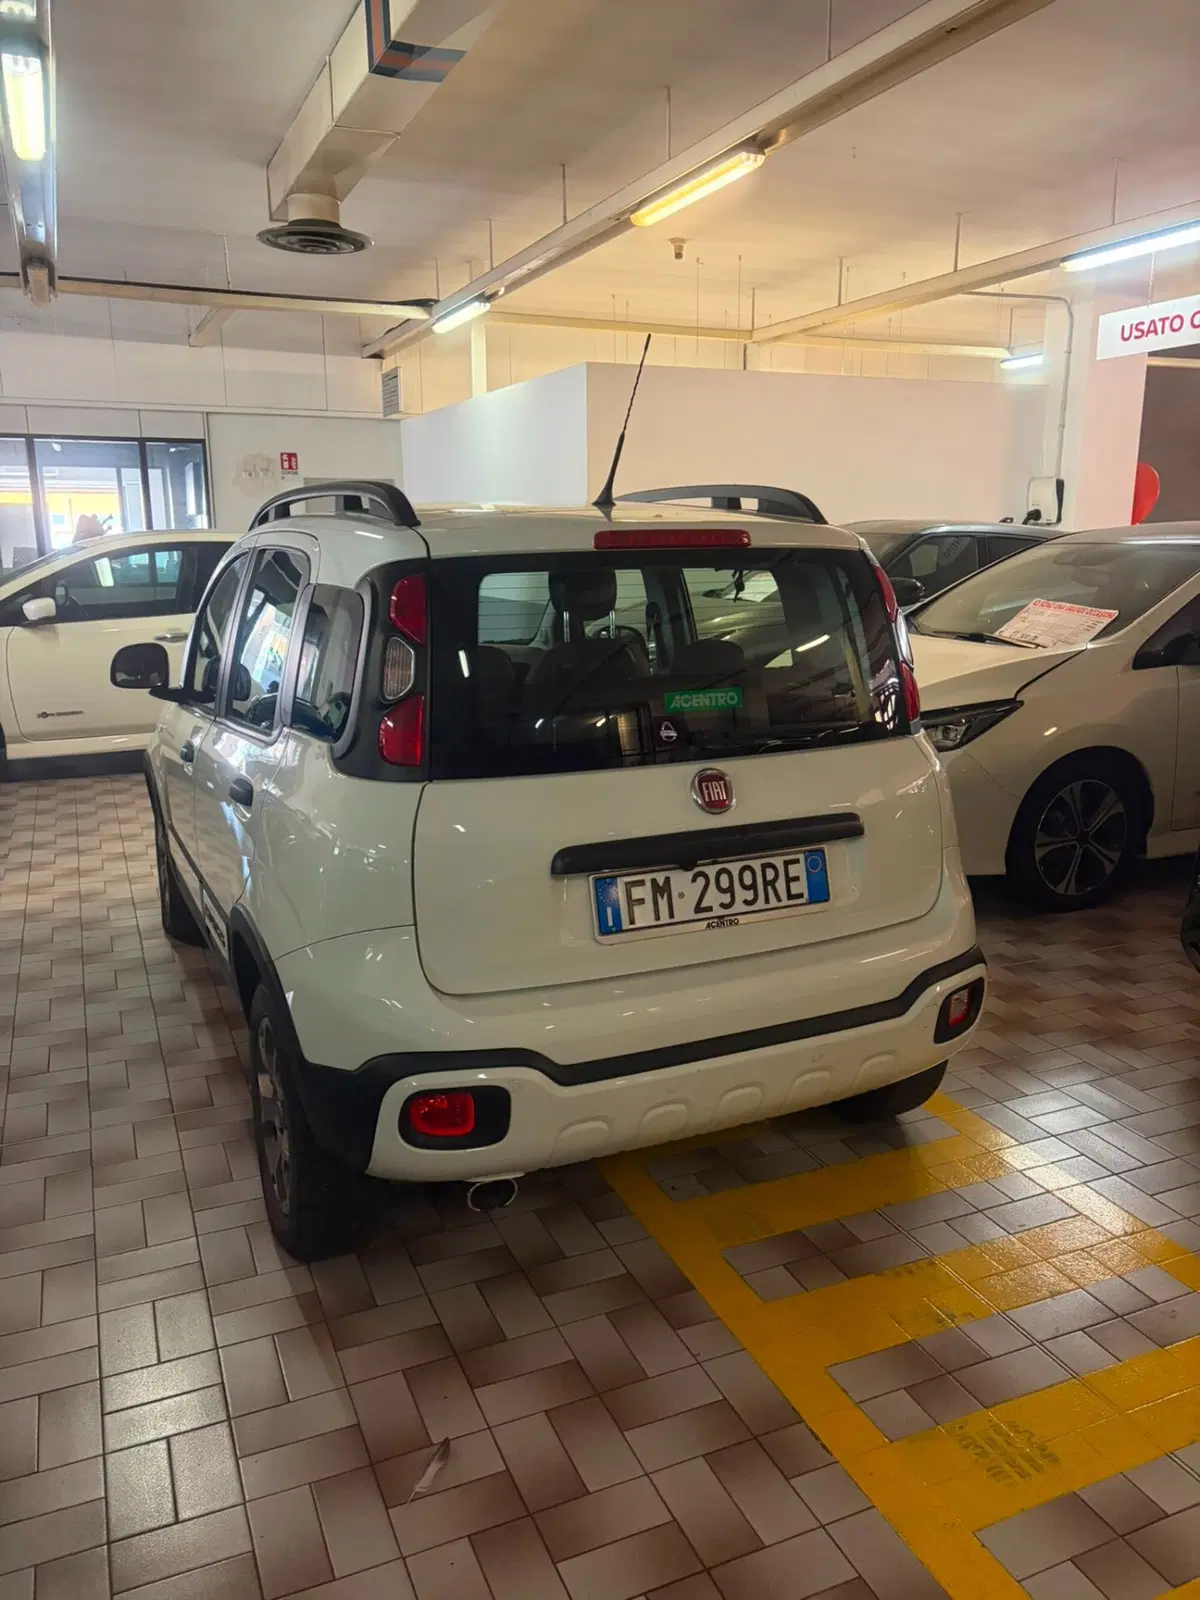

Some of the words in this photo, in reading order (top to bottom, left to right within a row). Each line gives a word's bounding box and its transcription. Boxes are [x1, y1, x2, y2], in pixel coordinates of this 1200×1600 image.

[1120, 314, 1184, 342] USATO
[670, 692, 738, 709] ACENTRO
[701, 780, 727, 802] FIAT
[624, 876, 675, 925] FM
[691, 858, 805, 915] 299RE
[705, 917, 740, 930] ACENTRO
